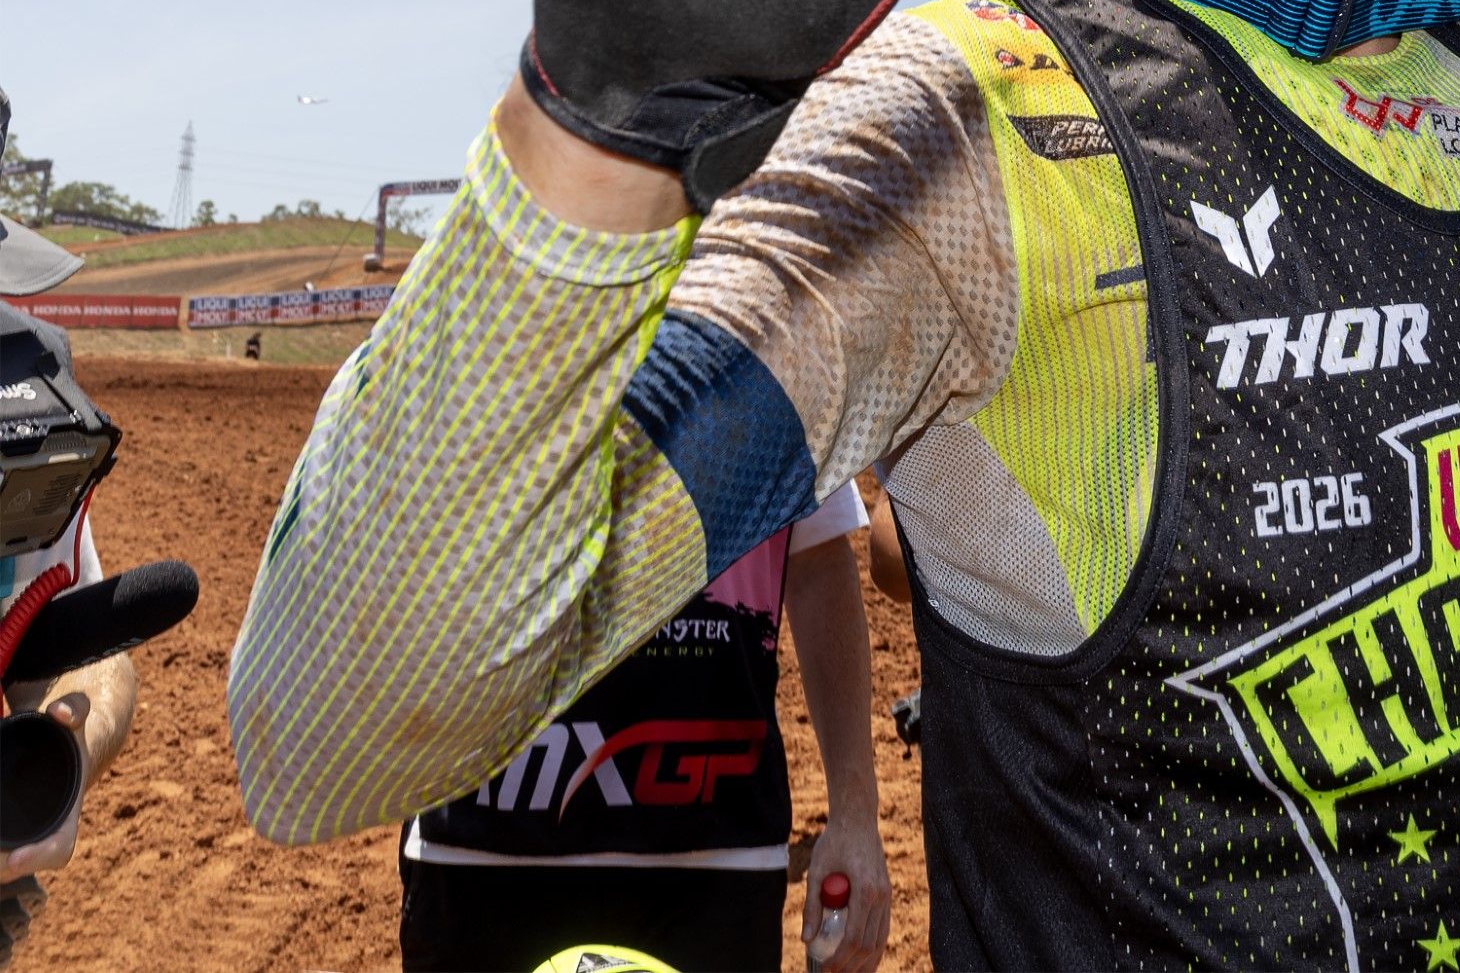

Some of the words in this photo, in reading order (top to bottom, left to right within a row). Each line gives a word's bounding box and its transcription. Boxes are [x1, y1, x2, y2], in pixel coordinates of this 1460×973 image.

[33, 304, 82, 316] HONDA
[83, 304, 131, 316] HONDA
[133, 305, 178, 317] HONDA
[1205, 303, 1431, 388] THOR
[1252, 472, 1372, 537] 2026
[656, 618, 731, 643] NSTER
